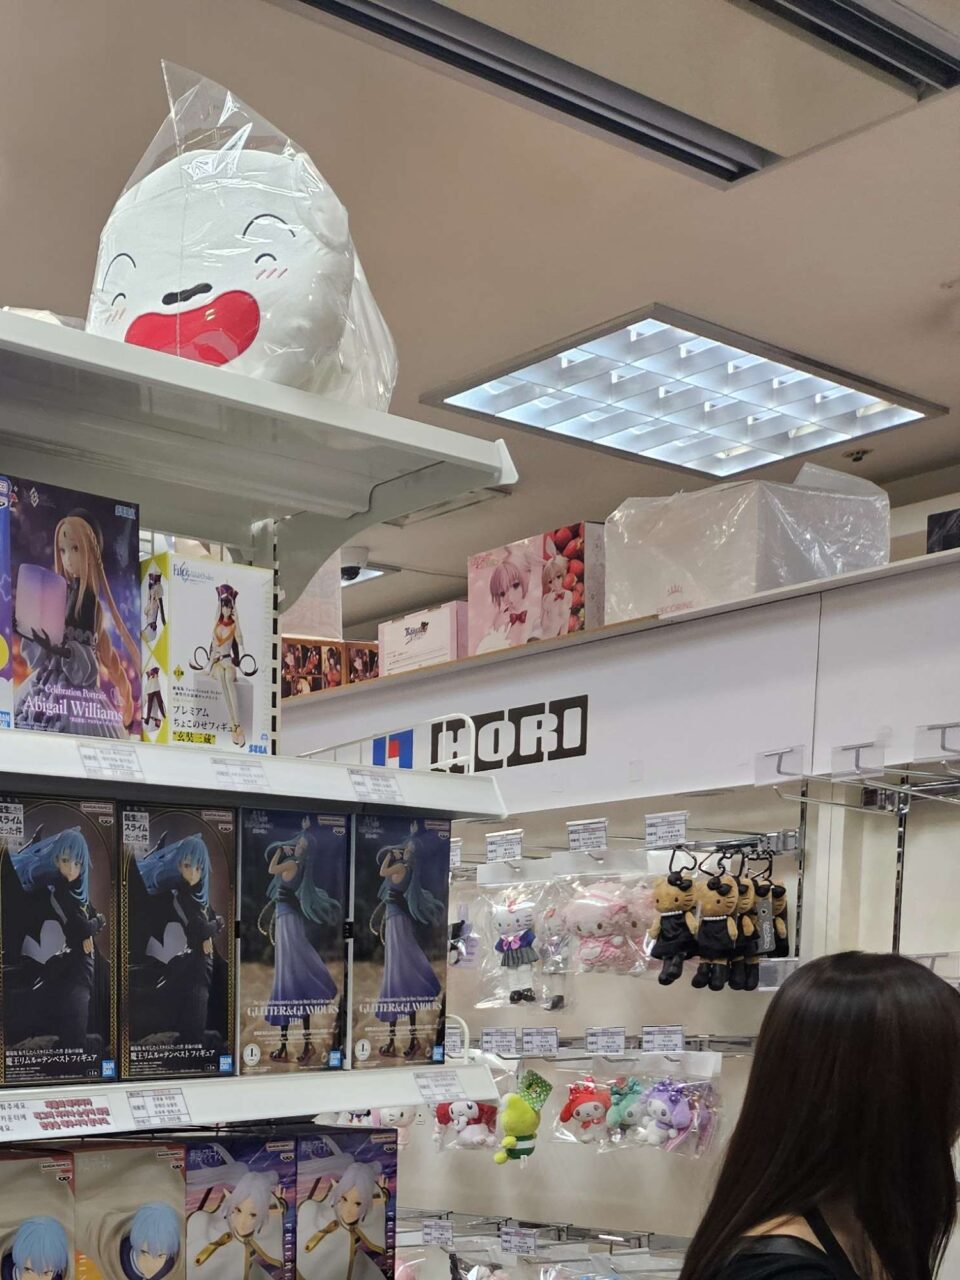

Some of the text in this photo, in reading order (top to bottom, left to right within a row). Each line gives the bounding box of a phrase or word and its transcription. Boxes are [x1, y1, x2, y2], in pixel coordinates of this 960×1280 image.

[44, 684, 80, 698] Celebration
[23, 695, 124, 721] Abigail Williams
[173, 705, 209, 718] プレミアム
[431, 694, 588, 774] HORI
[249, 743, 268, 754] SEGA
[124, 823, 149, 832] スライム
[247, 1005, 339, 1017] GLITTER&GLAMOURS
